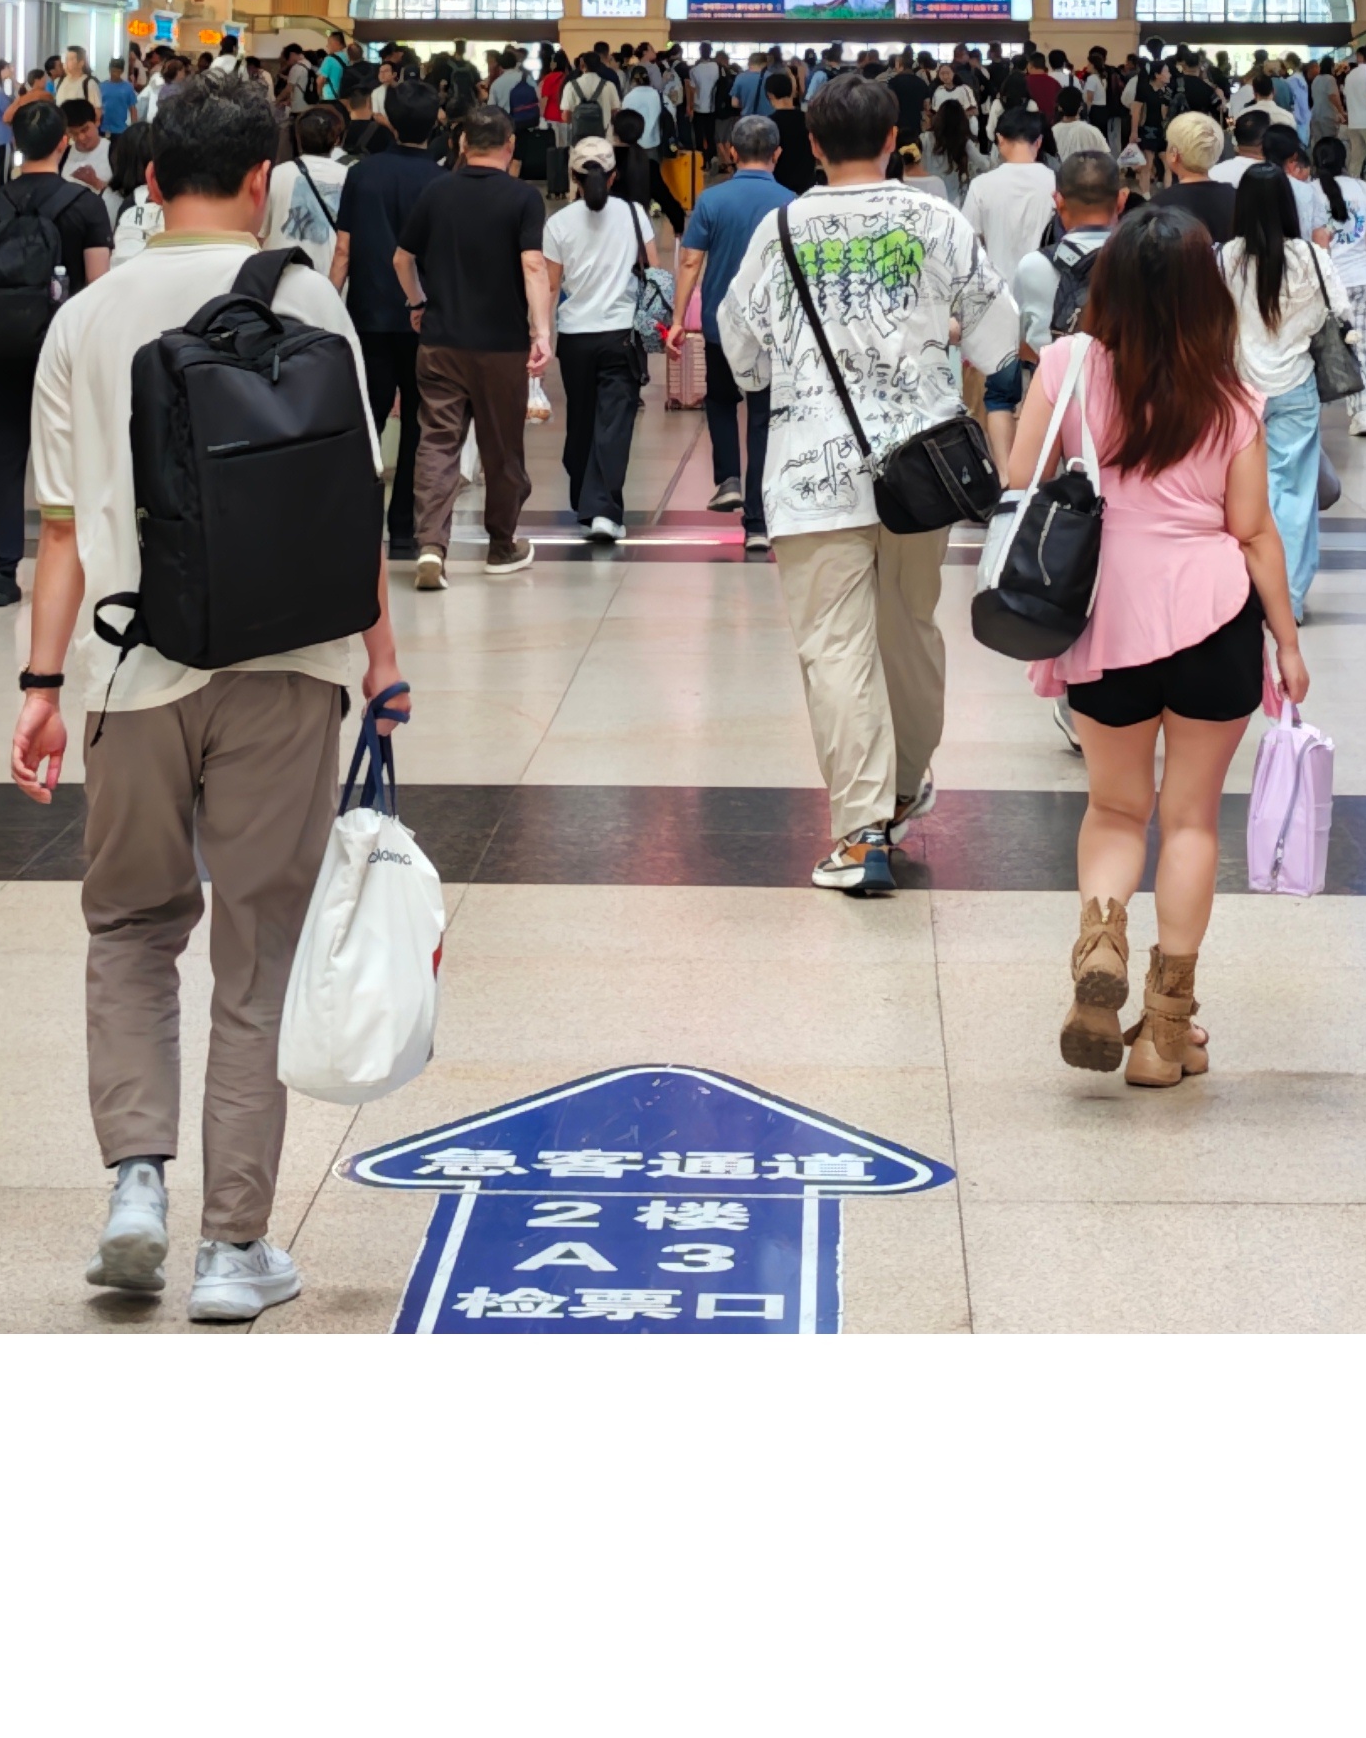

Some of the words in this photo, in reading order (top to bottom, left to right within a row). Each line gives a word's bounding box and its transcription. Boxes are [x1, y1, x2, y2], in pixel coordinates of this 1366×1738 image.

[413, 1148, 877, 1182] 急客通道
[452, 1286, 785, 1321] 检票口
